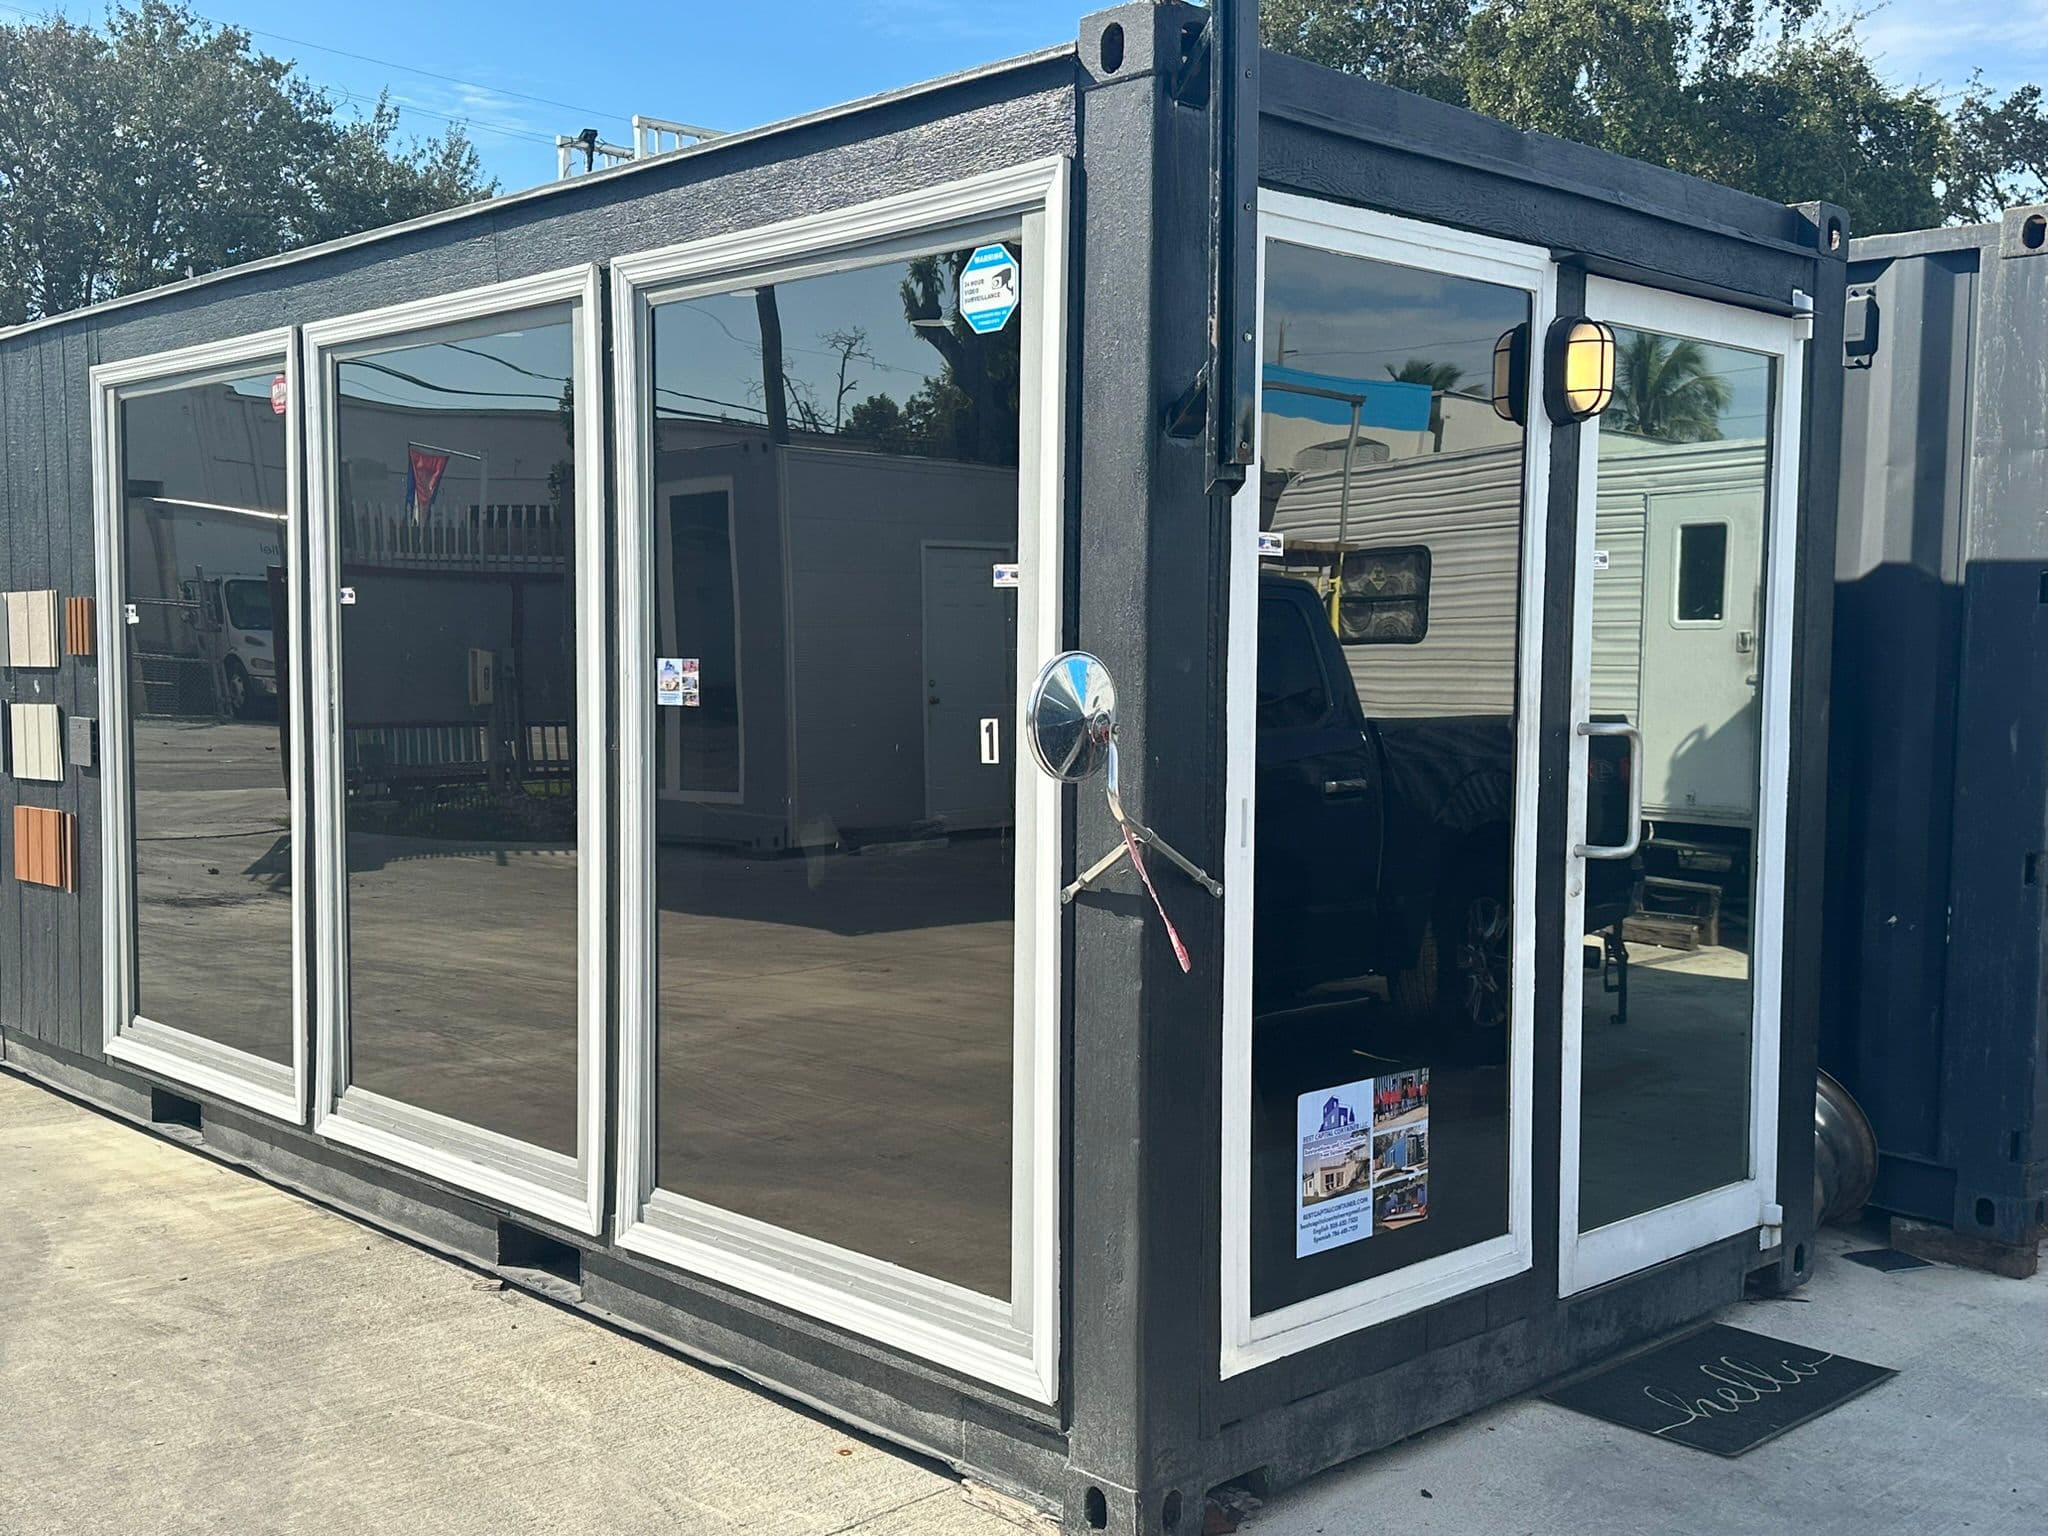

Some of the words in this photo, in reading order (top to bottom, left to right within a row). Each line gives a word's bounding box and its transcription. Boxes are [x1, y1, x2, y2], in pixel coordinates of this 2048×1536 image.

[964, 292, 1001, 304] SURVEILLANCE
[985, 721, 995, 761] 1
[1643, 1353, 1834, 1434] hello
